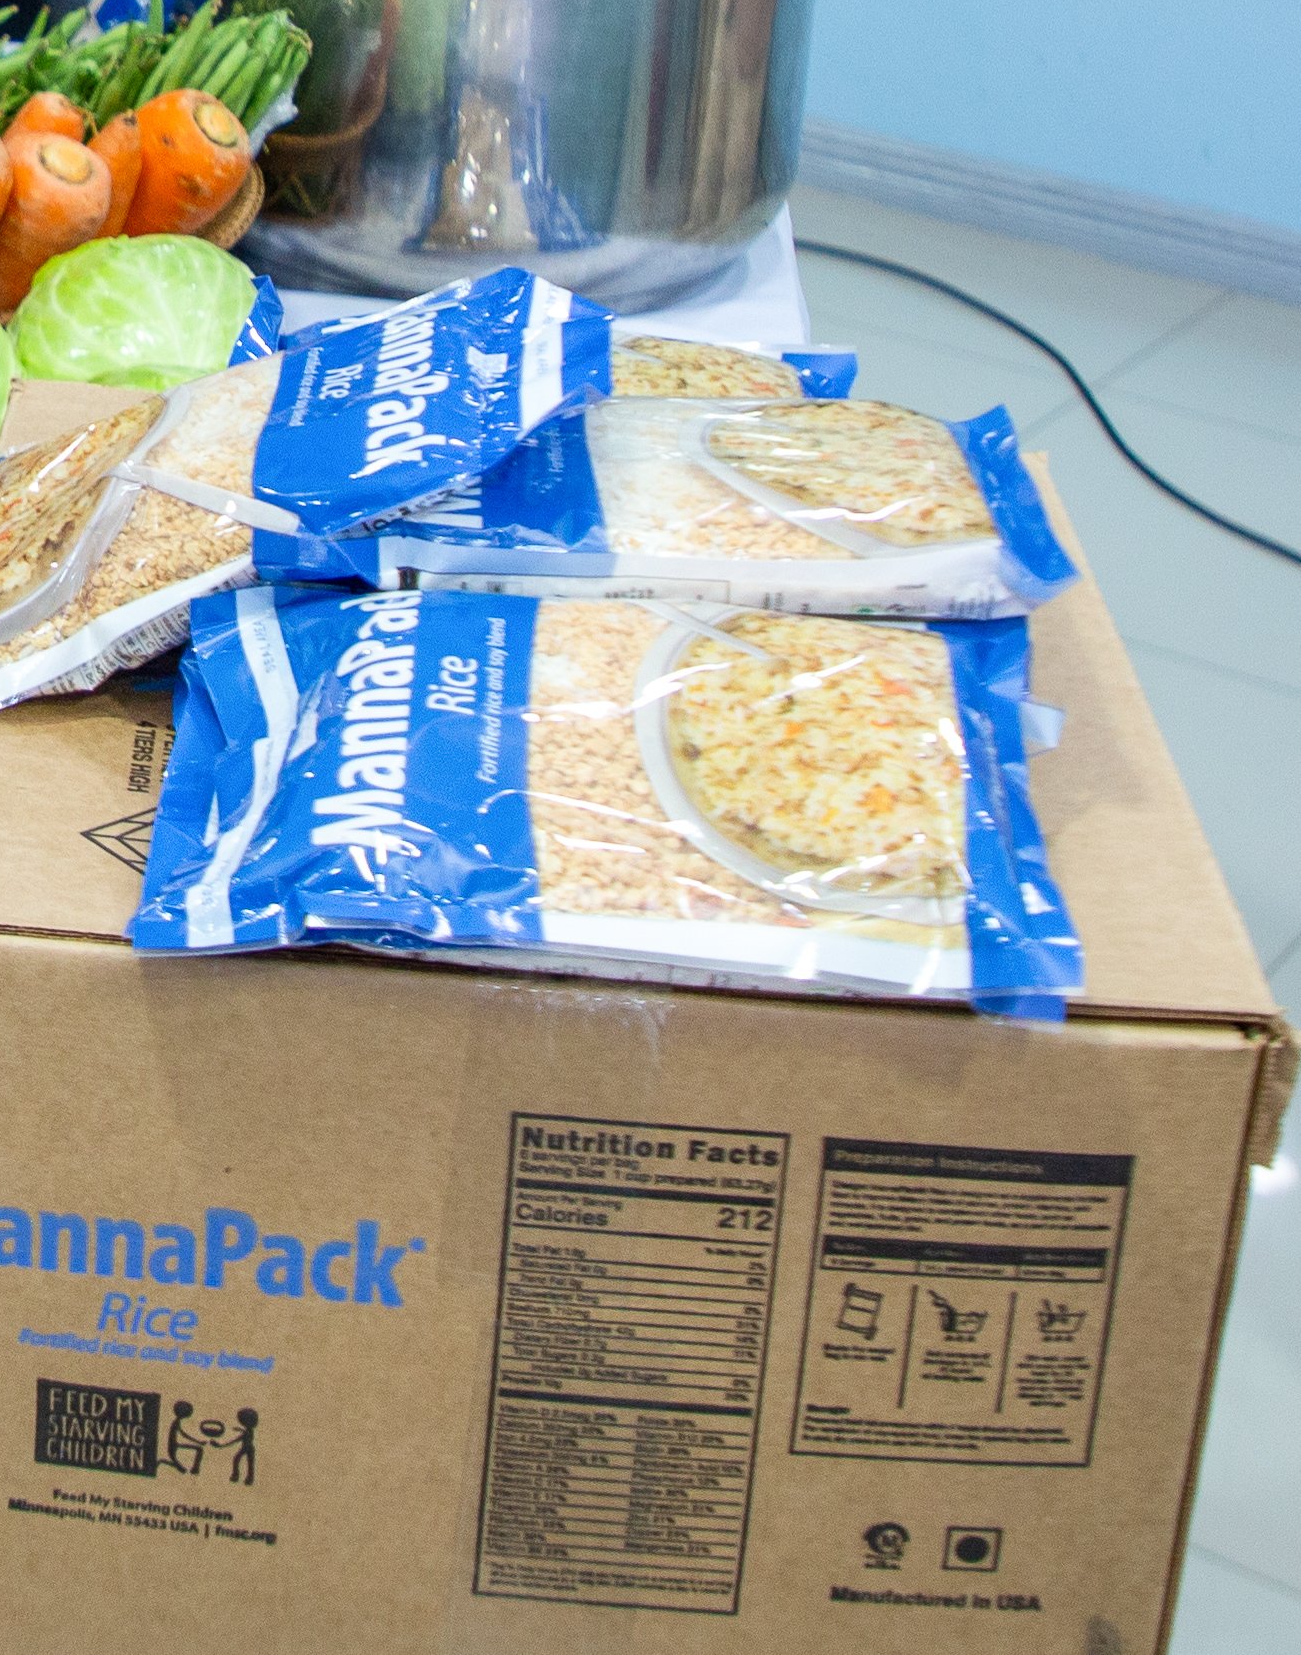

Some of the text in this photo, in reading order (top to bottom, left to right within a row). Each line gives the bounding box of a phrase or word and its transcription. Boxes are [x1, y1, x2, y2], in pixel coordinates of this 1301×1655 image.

[319, 362, 364, 400] Rice
[425, 655, 478, 715] Rice
[475, 617, 509, 784] Fortified rice and soy blend
[131, 728, 157, 767] TIERS
[127, 764, 153, 794] HIGH
[522, 1126, 780, 1168] Nutrition Facts
[532, 1150, 587, 1166] servings
[519, 1161, 574, 1178] Serving
[515, 1202, 774, 1232] Calories 212
[97, 1291, 199, 1341] Rice
[140, 1346, 180, 1363] and
[49, 1387, 146, 1423] FEED MY
[48, 1414, 146, 1446] STARVING
[47, 1437, 145, 1471] CHILDREN
[53, 1488, 234, 1523] Feed My Starving Children
[98, 1511, 122, 1525] MN
[170, 1520, 199, 1534] USA
[829, 1585, 968, 1609] Manufactured
[996, 1594, 1042, 1612] USA
